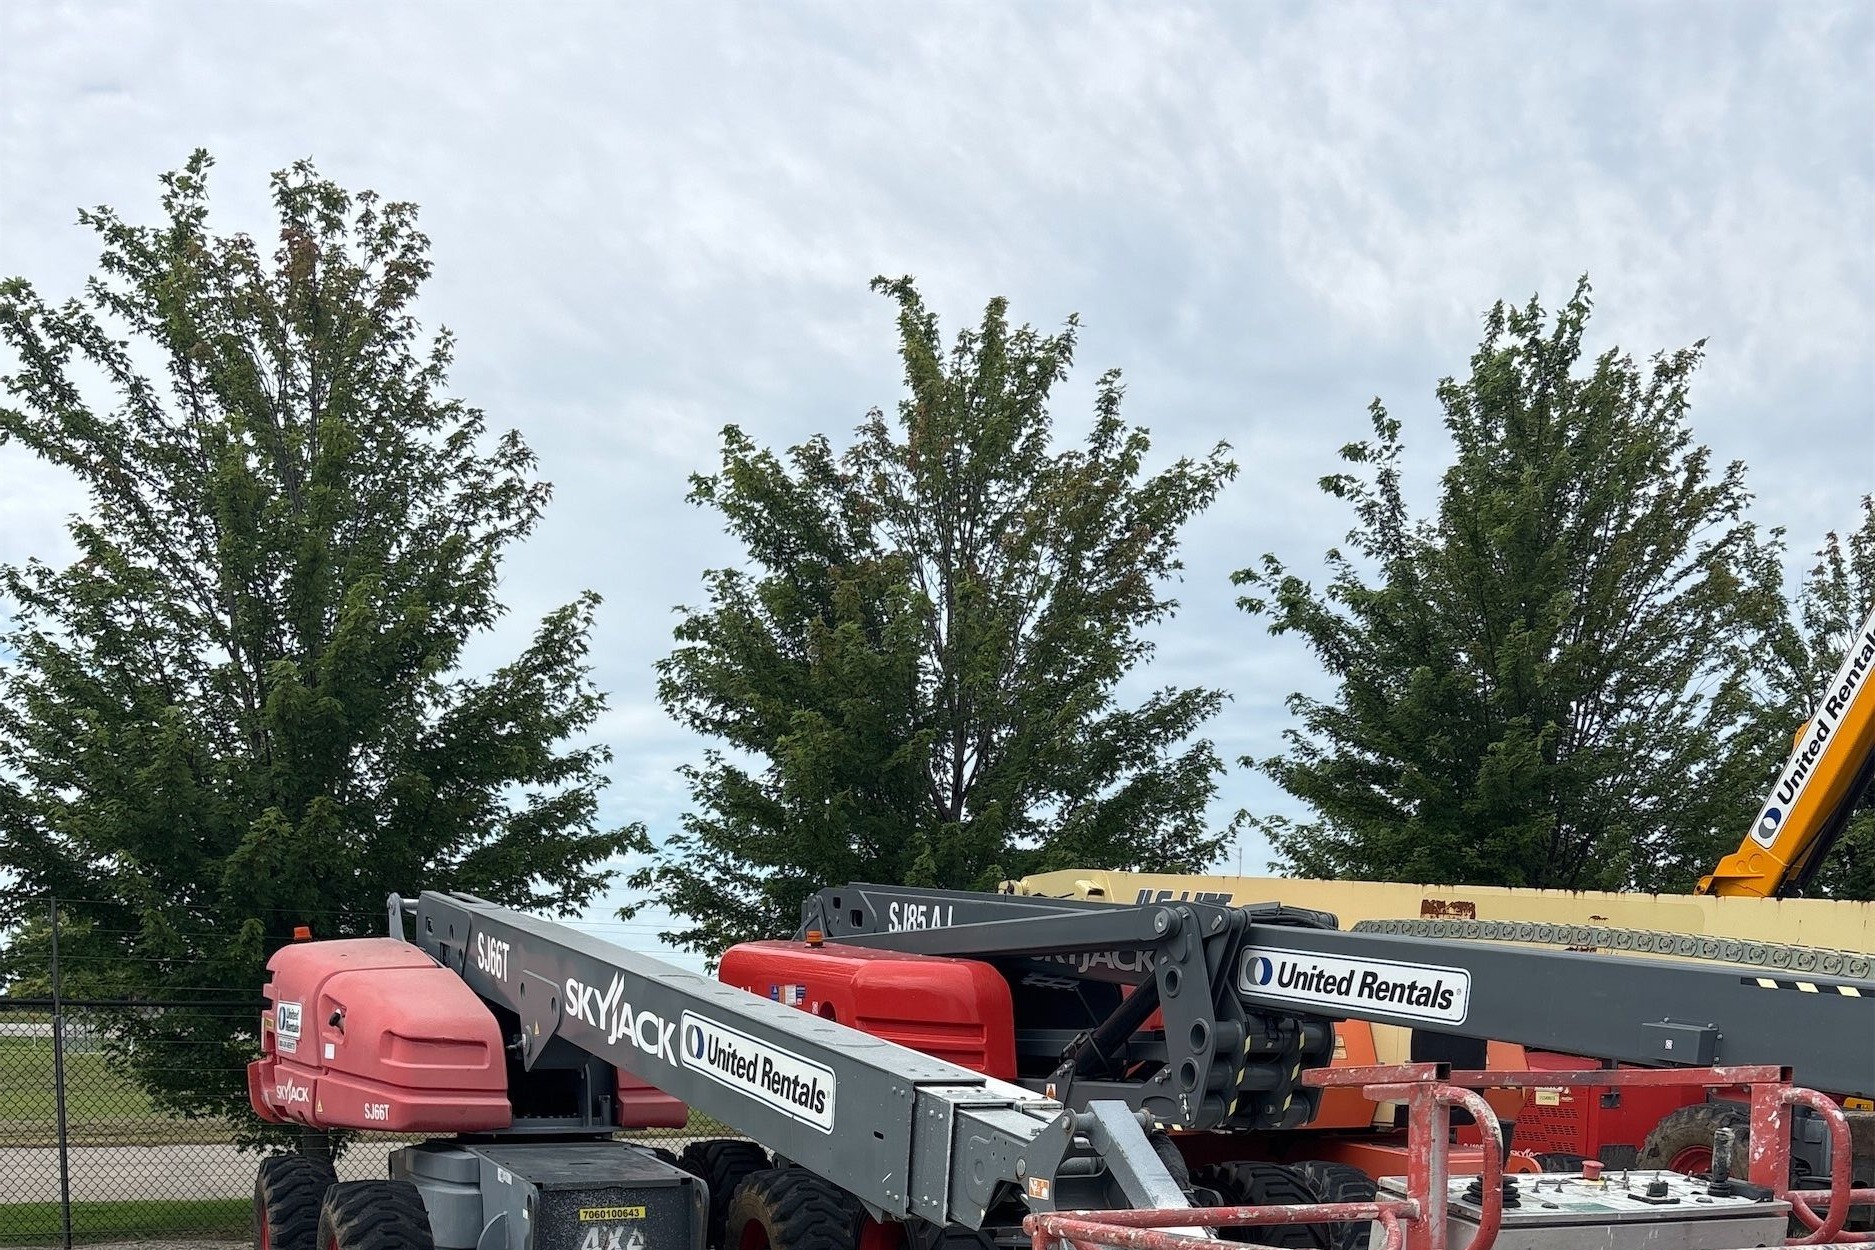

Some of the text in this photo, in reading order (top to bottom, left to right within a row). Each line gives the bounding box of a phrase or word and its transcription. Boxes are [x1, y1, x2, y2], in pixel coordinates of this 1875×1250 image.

[1777, 628, 1875, 806] United Rental
[477, 931, 510, 983] SJ66T
[1277, 961, 1455, 1010] United Rentals
[565, 970, 679, 1068] SKYJACK
[276, 1077, 310, 1105] SKYJACK
[707, 1033, 826, 1115] United Rentals
[364, 1102, 390, 1121] SJ66T
[582, 1208, 640, 1220] 7060100643
